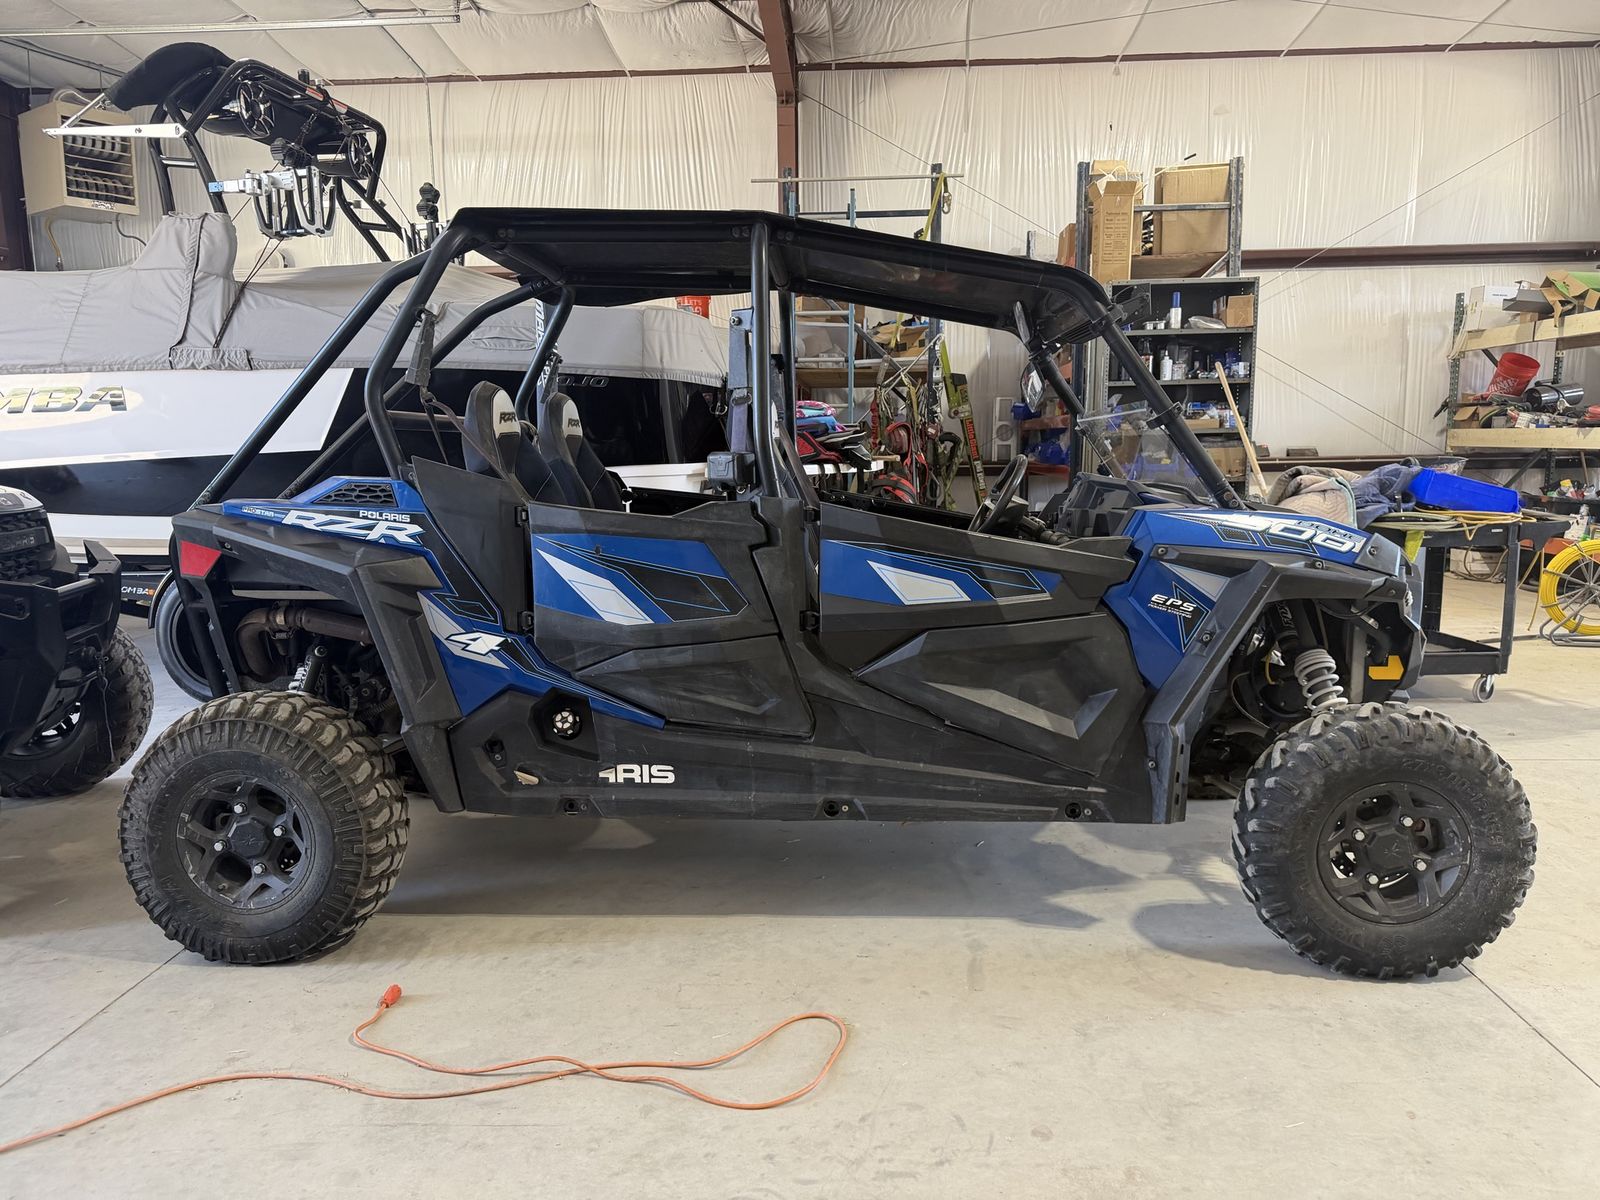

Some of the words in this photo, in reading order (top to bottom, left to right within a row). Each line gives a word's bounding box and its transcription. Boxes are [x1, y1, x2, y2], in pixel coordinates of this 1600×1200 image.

[499, 411, 516, 424] RZR
[567, 417, 580, 428] RZR
[359, 510, 411, 523] POLARIS
[281, 509, 427, 547] RZR
[1151, 594, 1197, 611] EPS
[446, 631, 507, 656] 4
